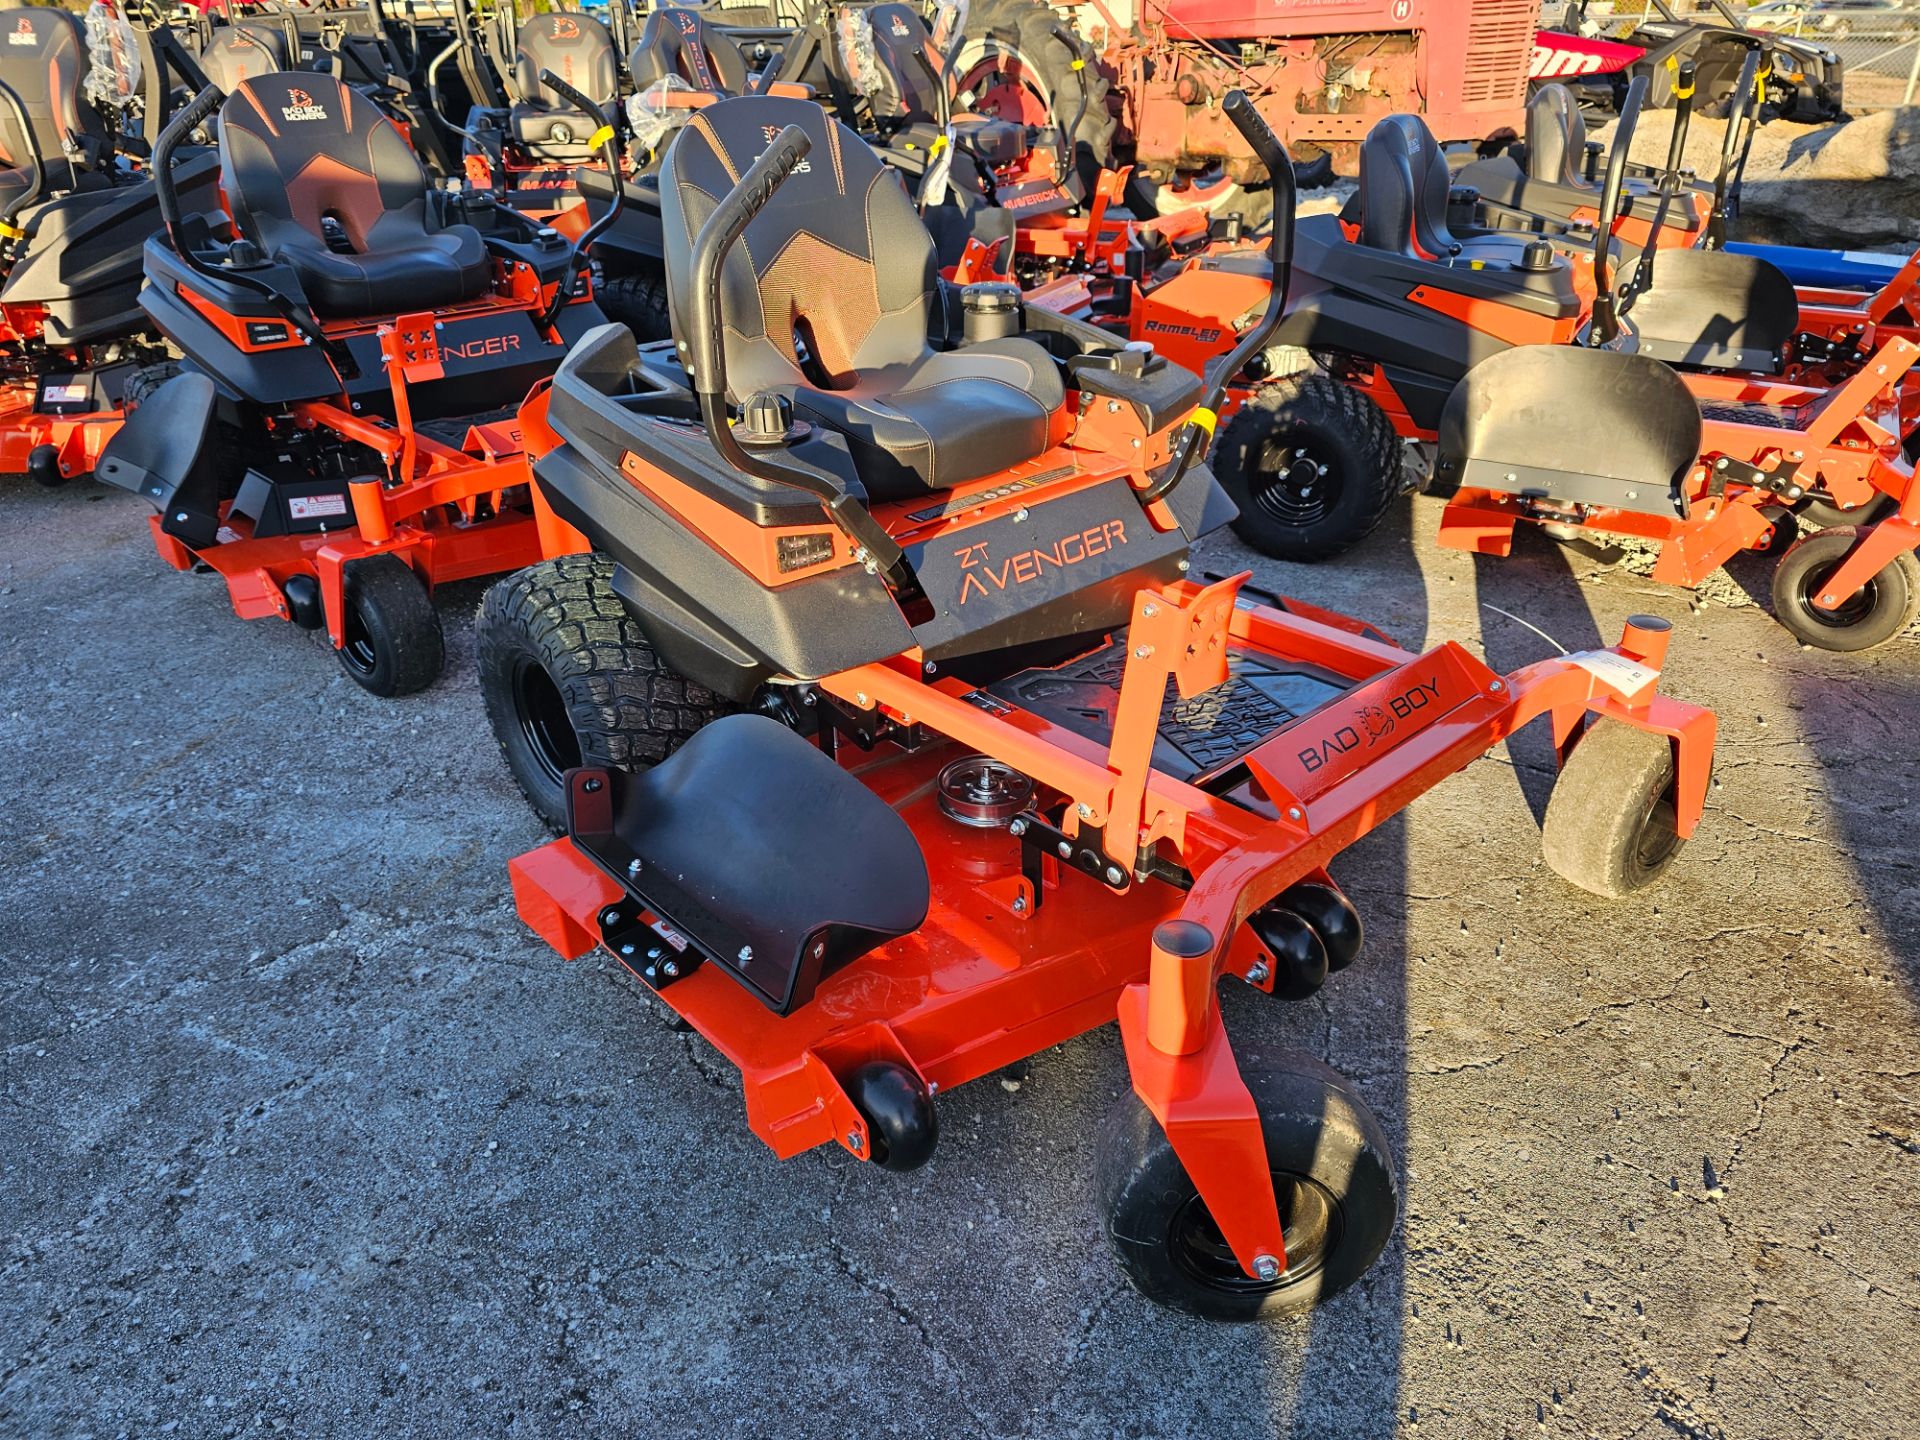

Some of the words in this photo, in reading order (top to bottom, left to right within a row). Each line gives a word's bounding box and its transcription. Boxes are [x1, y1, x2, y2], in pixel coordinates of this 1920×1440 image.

[1395, 1, 1408, 17] H
[284, 112, 328, 121] MOWERS
[304, 105, 323, 113] BOY
[740, 145, 799, 219] BAD
[1003, 189, 1059, 209] MAVERICK
[954, 541, 989, 569] ZT
[960, 519, 1128, 605] AVENGER
[1297, 726, 1361, 773] BAD
[1389, 677, 1440, 719] BOY
